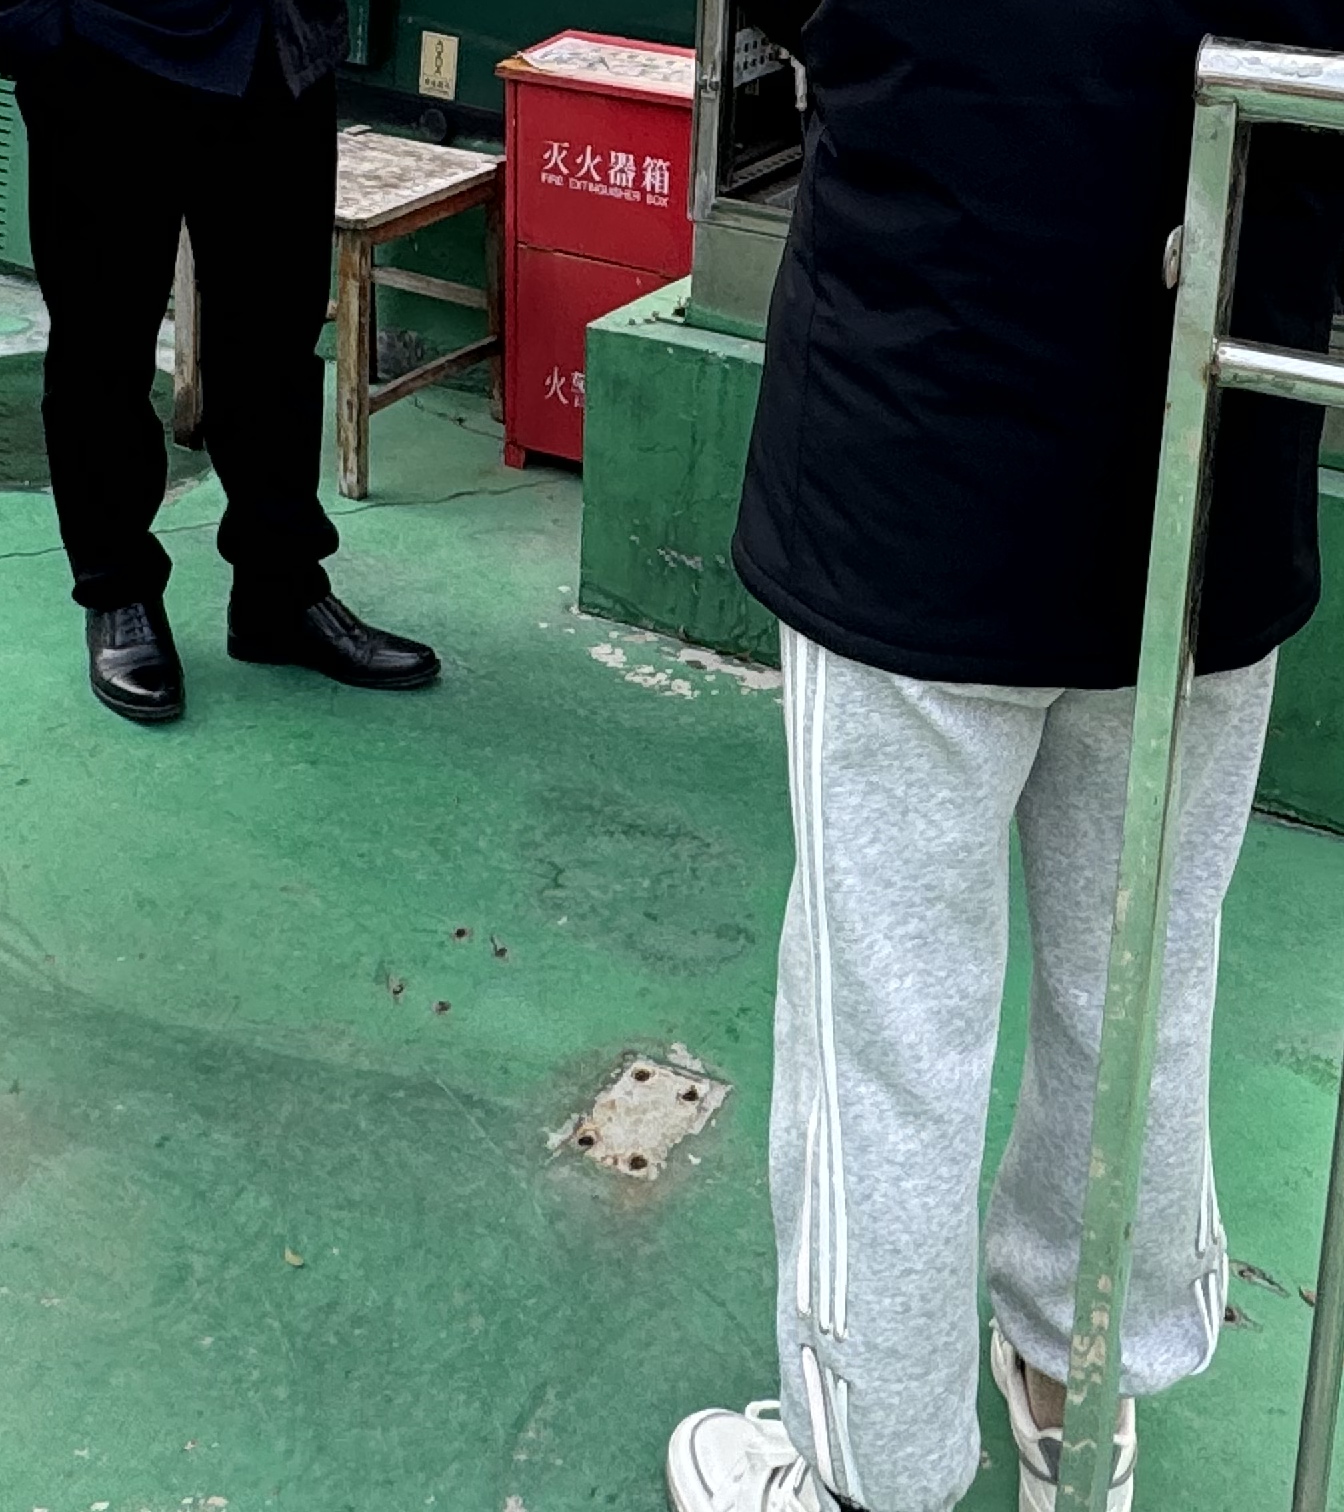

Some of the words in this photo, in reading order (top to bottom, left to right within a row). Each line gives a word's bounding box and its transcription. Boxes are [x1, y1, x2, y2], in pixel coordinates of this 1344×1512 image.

[542, 140, 671, 195] 灭火器箱
[646, 193, 669, 208] BOX
